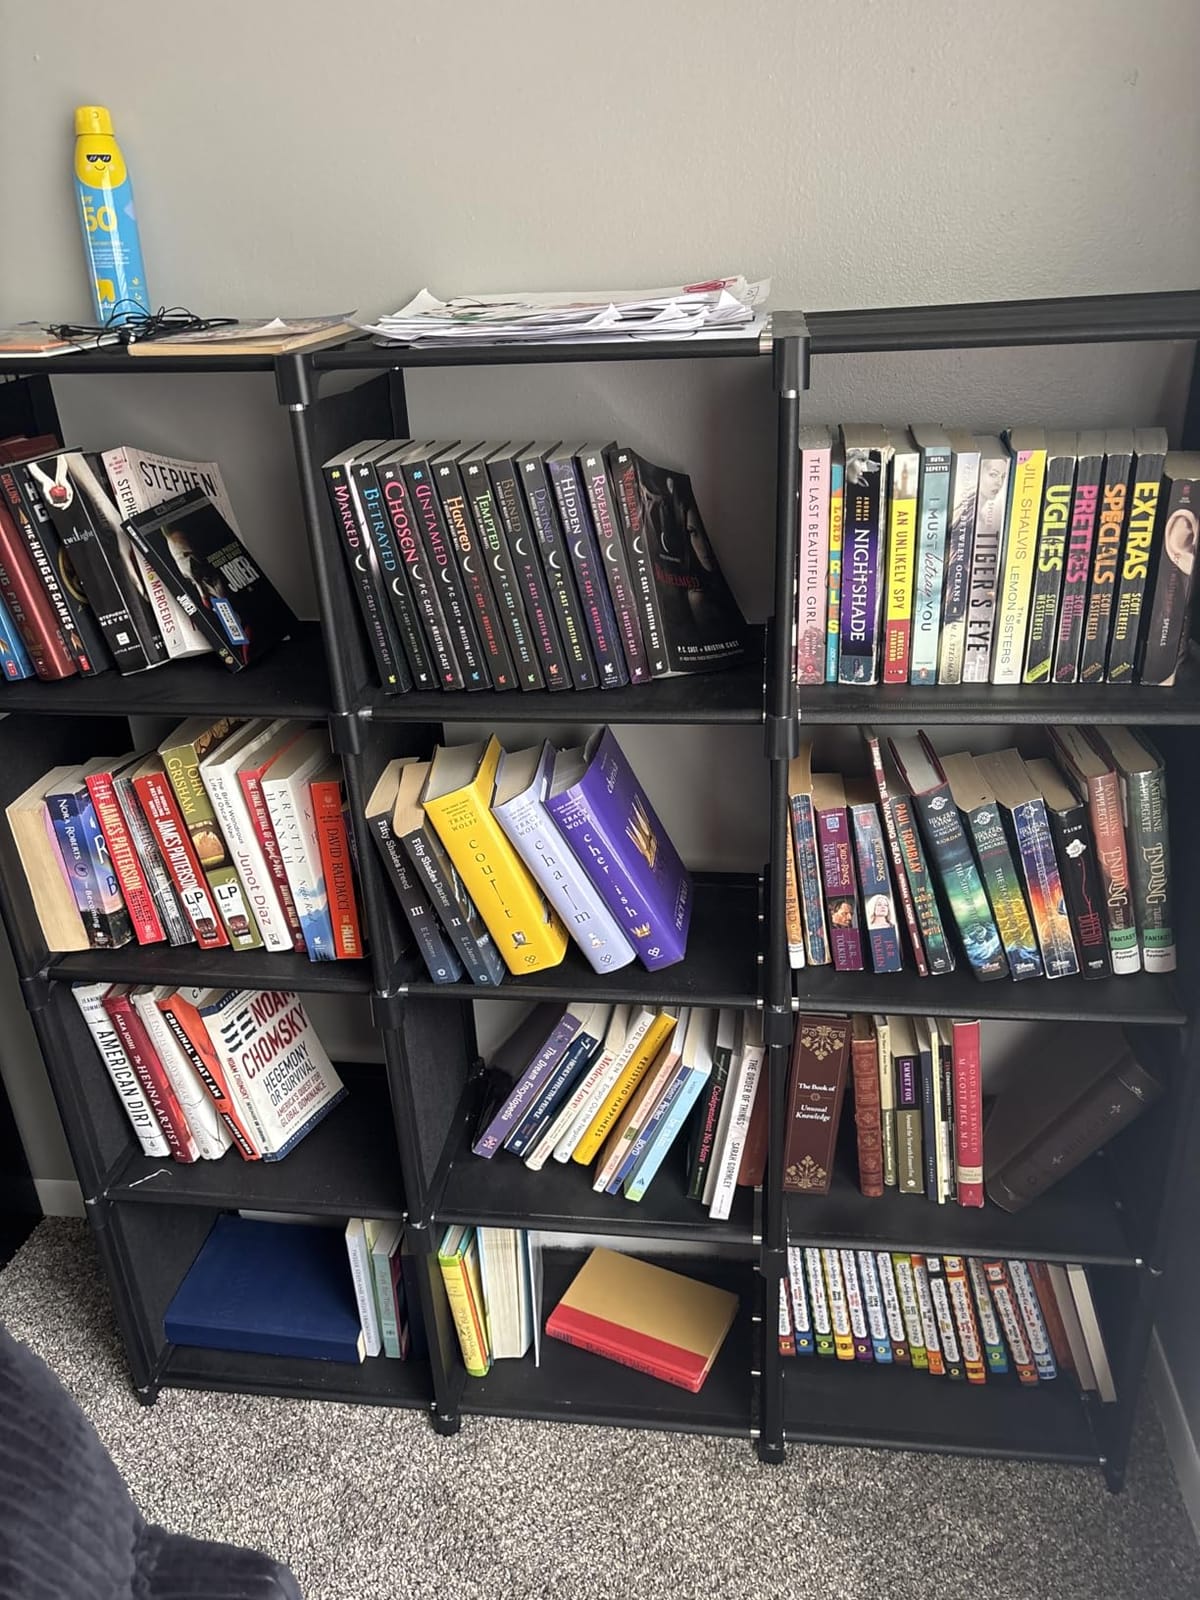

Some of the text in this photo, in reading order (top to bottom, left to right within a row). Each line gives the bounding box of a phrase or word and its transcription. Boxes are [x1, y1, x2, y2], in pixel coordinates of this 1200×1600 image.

[334, 485, 360, 548] MARKED
[364, 487, 397, 571] BETRAYED
[385, 482, 419, 563] CHOSEN
[416, 484, 448, 566] UNTAMED
[447, 496, 471, 552] HUNTED
[476, 491, 500, 551] TEMPTED
[501, 479, 522, 533] BURNED
[535, 488, 554, 544] DESTINED
[561, 477, 582, 534] HIDDEN
[592, 474, 613, 538] REVEALED
[832, 506, 840, 542] LORD
[1014, 463, 1036, 560] JILL SHALVIS
[1122, 479, 1160, 582] EXTRAS
[64, 526, 94, 546] twilight
[806, 457, 820, 624] THE LAST BEAUTIFUL GIRL
[892, 511, 907, 609] AN UNLIKELY SPY
[1092, 482, 1127, 585] SPECIALS
[23, 523, 75, 630] THE HUNGER GAMES
[220, 556, 260, 592] JOKER
[850, 528, 873, 641] NIGHTSHADE
[920, 508, 944, 631] MUST betray YOU
[952, 564, 963, 602] OCEANS
[101, 615, 128, 626] MEYER
[150, 579, 177, 633] MERCEDES
[1000, 565, 1021, 664] LEMON SISTERS
[1031, 593, 1046, 640] WESTERFELD
[1044, 593, 1056, 616] SCOTT
[1115, 592, 1131, 640] WESTERFELD
[1129, 591, 1141, 615] SCOTT
[422, 598, 450, 670] CAST KRISTIN CAST
[449, 600, 475, 667] CAST KRISTIN CAST
[967, 620, 990, 652] EYE
[1159, 617, 1169, 646] SPECIALS
[163, 755, 200, 815] GRISHAM
[183, 761, 206, 797] JOHN
[207, 777, 229, 823] Life Oscar
[1149, 778, 1163, 832] KATHERINE
[57, 798, 81, 860] NORA ROBERTS
[154, 813, 183, 849] JAMES
[214, 776, 245, 844] The Brief Wondrous
[245, 778, 272, 839] THE FINAL REVIVAL OF
[265, 792, 293, 865] HANNAH
[277, 788, 307, 865] KRISTIN
[449, 811, 474, 825] TRACY
[451, 818, 477, 832] WOLFF
[563, 809, 588, 825] TRACY
[878, 781, 902, 864] THE WALKING DEAD
[1094, 785, 1109, 836] APPLEGATE
[1104, 783, 1119, 835] KATHERINE
[1137, 781, 1151, 832] APPLEGATE
[96, 799, 144, 892] JAMES PATTERSON
[376, 819, 411, 890] Fifty Shades Freed
[827, 842, 839, 887] THE RETURN
[894, 803, 922, 874] PAUL TREMBLAY
[165, 843, 201, 895] PATTERSON
[217, 886, 237, 900] LP
[234, 848, 262, 892] Junot
[326, 827, 349, 910] DAVID BALDACCI
[411, 837, 451, 907] Fifty Shades Darker
[824, 870, 832, 887] KING
[1100, 846, 1128, 907] ENDLING
[1141, 842, 1166, 903] ENDLING
[83, 889, 101, 928] Becoming
[135, 889, 154, 922] KILLER
[185, 892, 203, 906] LP
[410, 905, 423, 917] III
[451, 916, 461, 927] II
[835, 934, 847, 965] TOLKIEN
[872, 934, 886, 967] TOLKIEN
[114, 1013, 135, 1050] ALKA JOSHI
[164, 1011, 221, 1098] CRIMINAL THAT AM
[242, 1003, 308, 1079] CHOMSKY
[611, 1020, 648, 1073] JOEL OSTEEN
[97, 1030, 153, 1128] AMERICAN DIRT
[232, 1073, 249, 1101] CHOMSKY
[263, 1041, 310, 1094] HEGEMONY
[270, 1059, 316, 1107] OR SURVIVAL
[500, 1045, 556, 1124] The Dream Encyclopedia
[569, 1053, 612, 1110] Modern Love
[735, 1059, 758, 1127] THE ORDER OF THINGS
[798, 1082, 811, 1090] The
[903, 1062, 912, 1101] EMMET FOX
[958, 1072, 967, 1100] SCOTT
[135, 1063, 162, 1106] HENNA
[154, 1106, 180, 1148] ARTIST
[532, 1098, 550, 1120] PEOPLE
[594, 1054, 649, 1139] RESISTING HAPPINESS
[698, 1084, 721, 1162] Codependent No More
[796, 1111, 831, 1122] Knowledge
[801, 1105, 828, 1113] Unusual
[722, 1141, 740, 1188] SARAH GORMLEY
